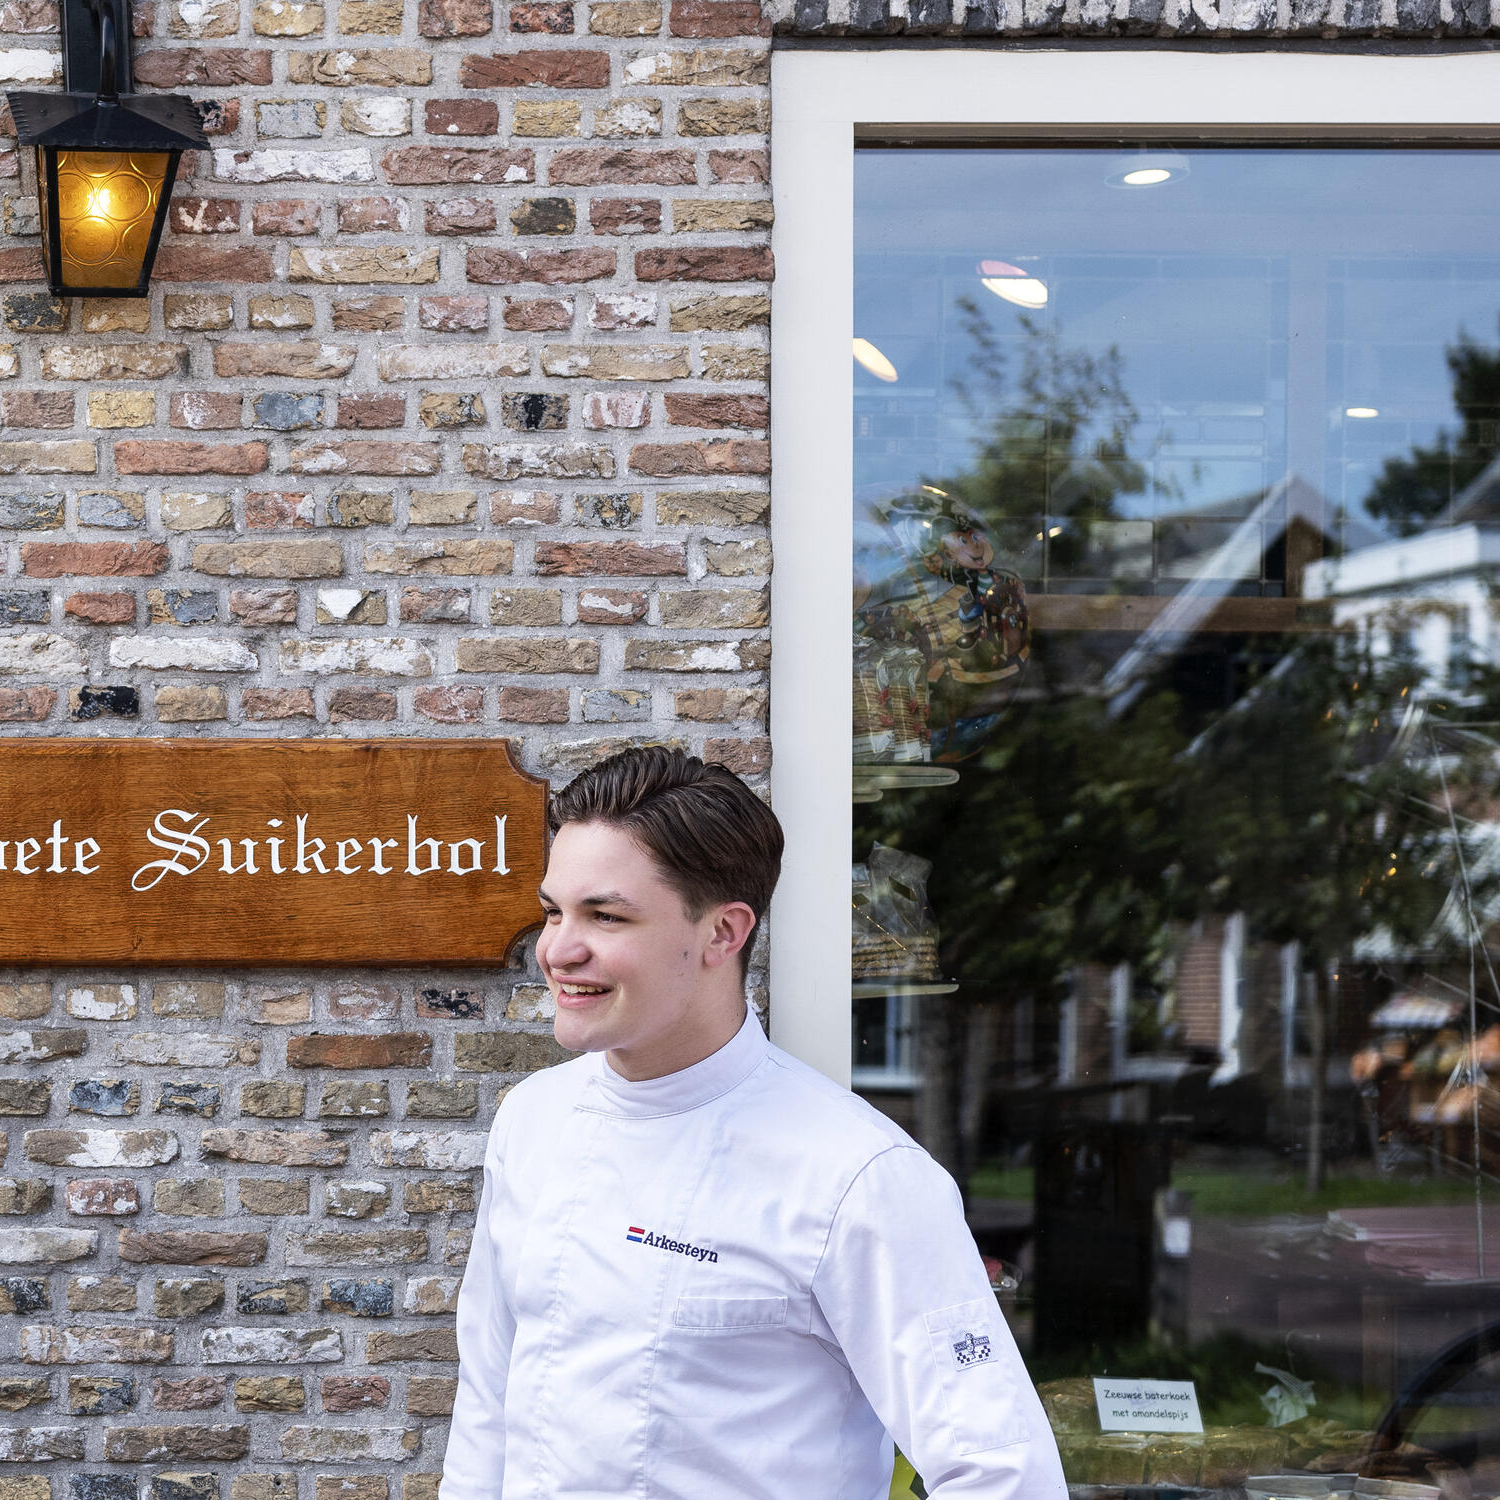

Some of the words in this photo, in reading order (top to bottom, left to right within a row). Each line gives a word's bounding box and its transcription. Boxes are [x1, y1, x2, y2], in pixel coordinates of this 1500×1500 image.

[131, 808, 511, 892] Suikerbol
[642, 1231, 719, 1264] Arkesteyn
[1103, 1389, 1142, 1400] Zeeuwse
[1112, 1409, 1129, 1417] met
[1131, 1409, 1189, 1422] amandelspijs
